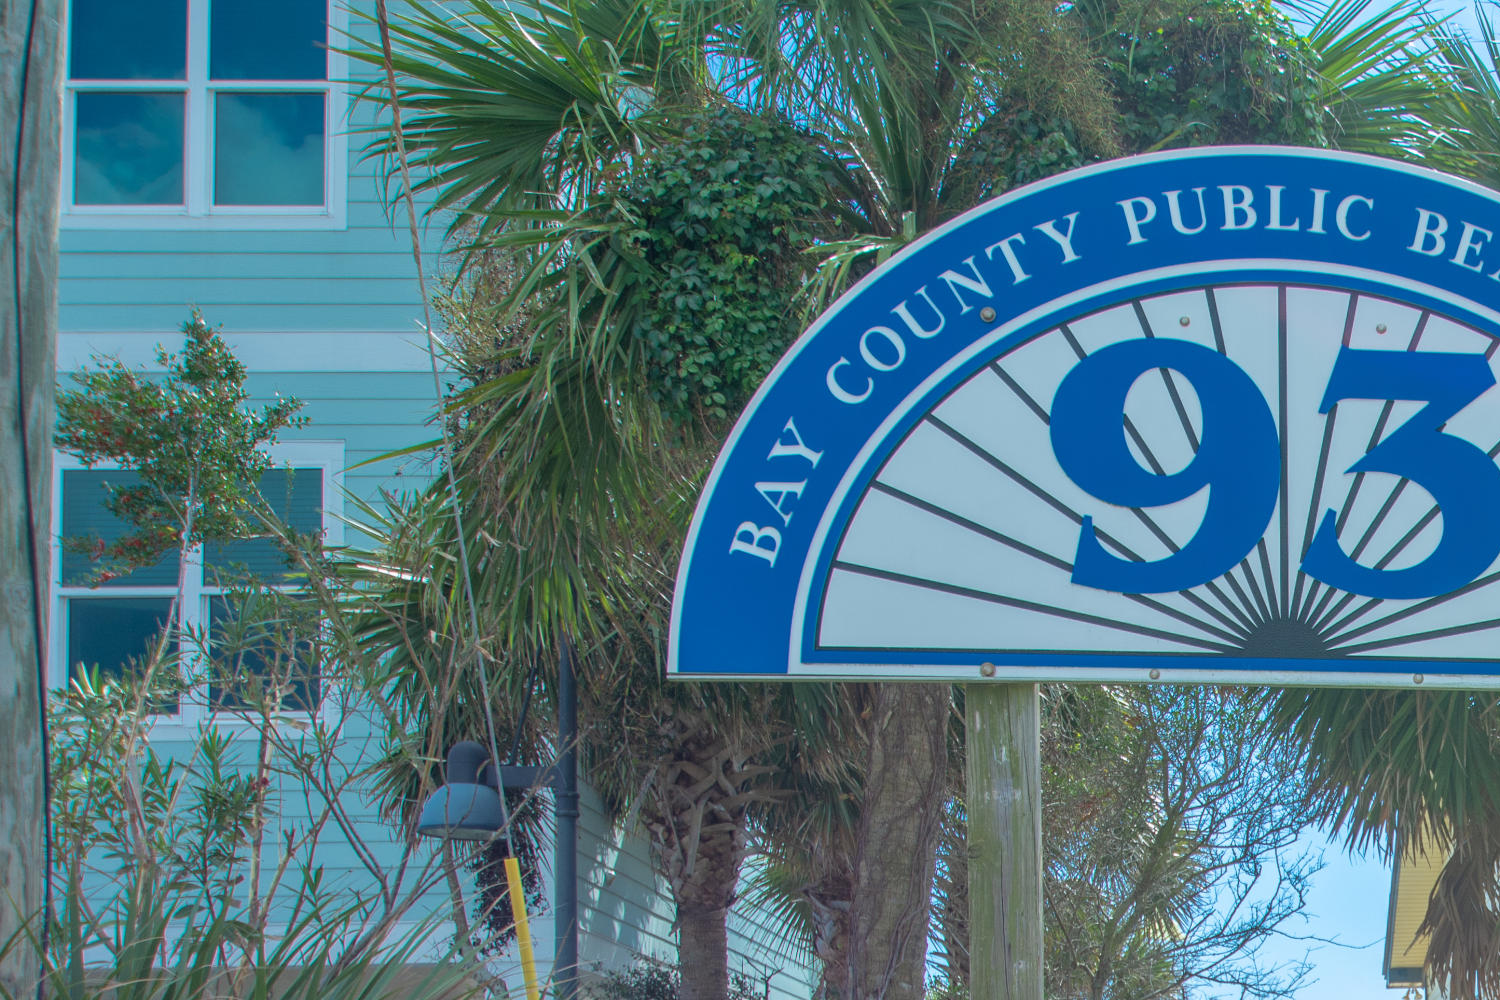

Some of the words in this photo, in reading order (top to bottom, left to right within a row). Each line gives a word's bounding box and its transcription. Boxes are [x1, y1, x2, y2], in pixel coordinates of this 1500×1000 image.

[729, 417, 825, 568] BAY
[826, 210, 1082, 405] COUNTY
[1115, 184, 1374, 246] PUBLIC
